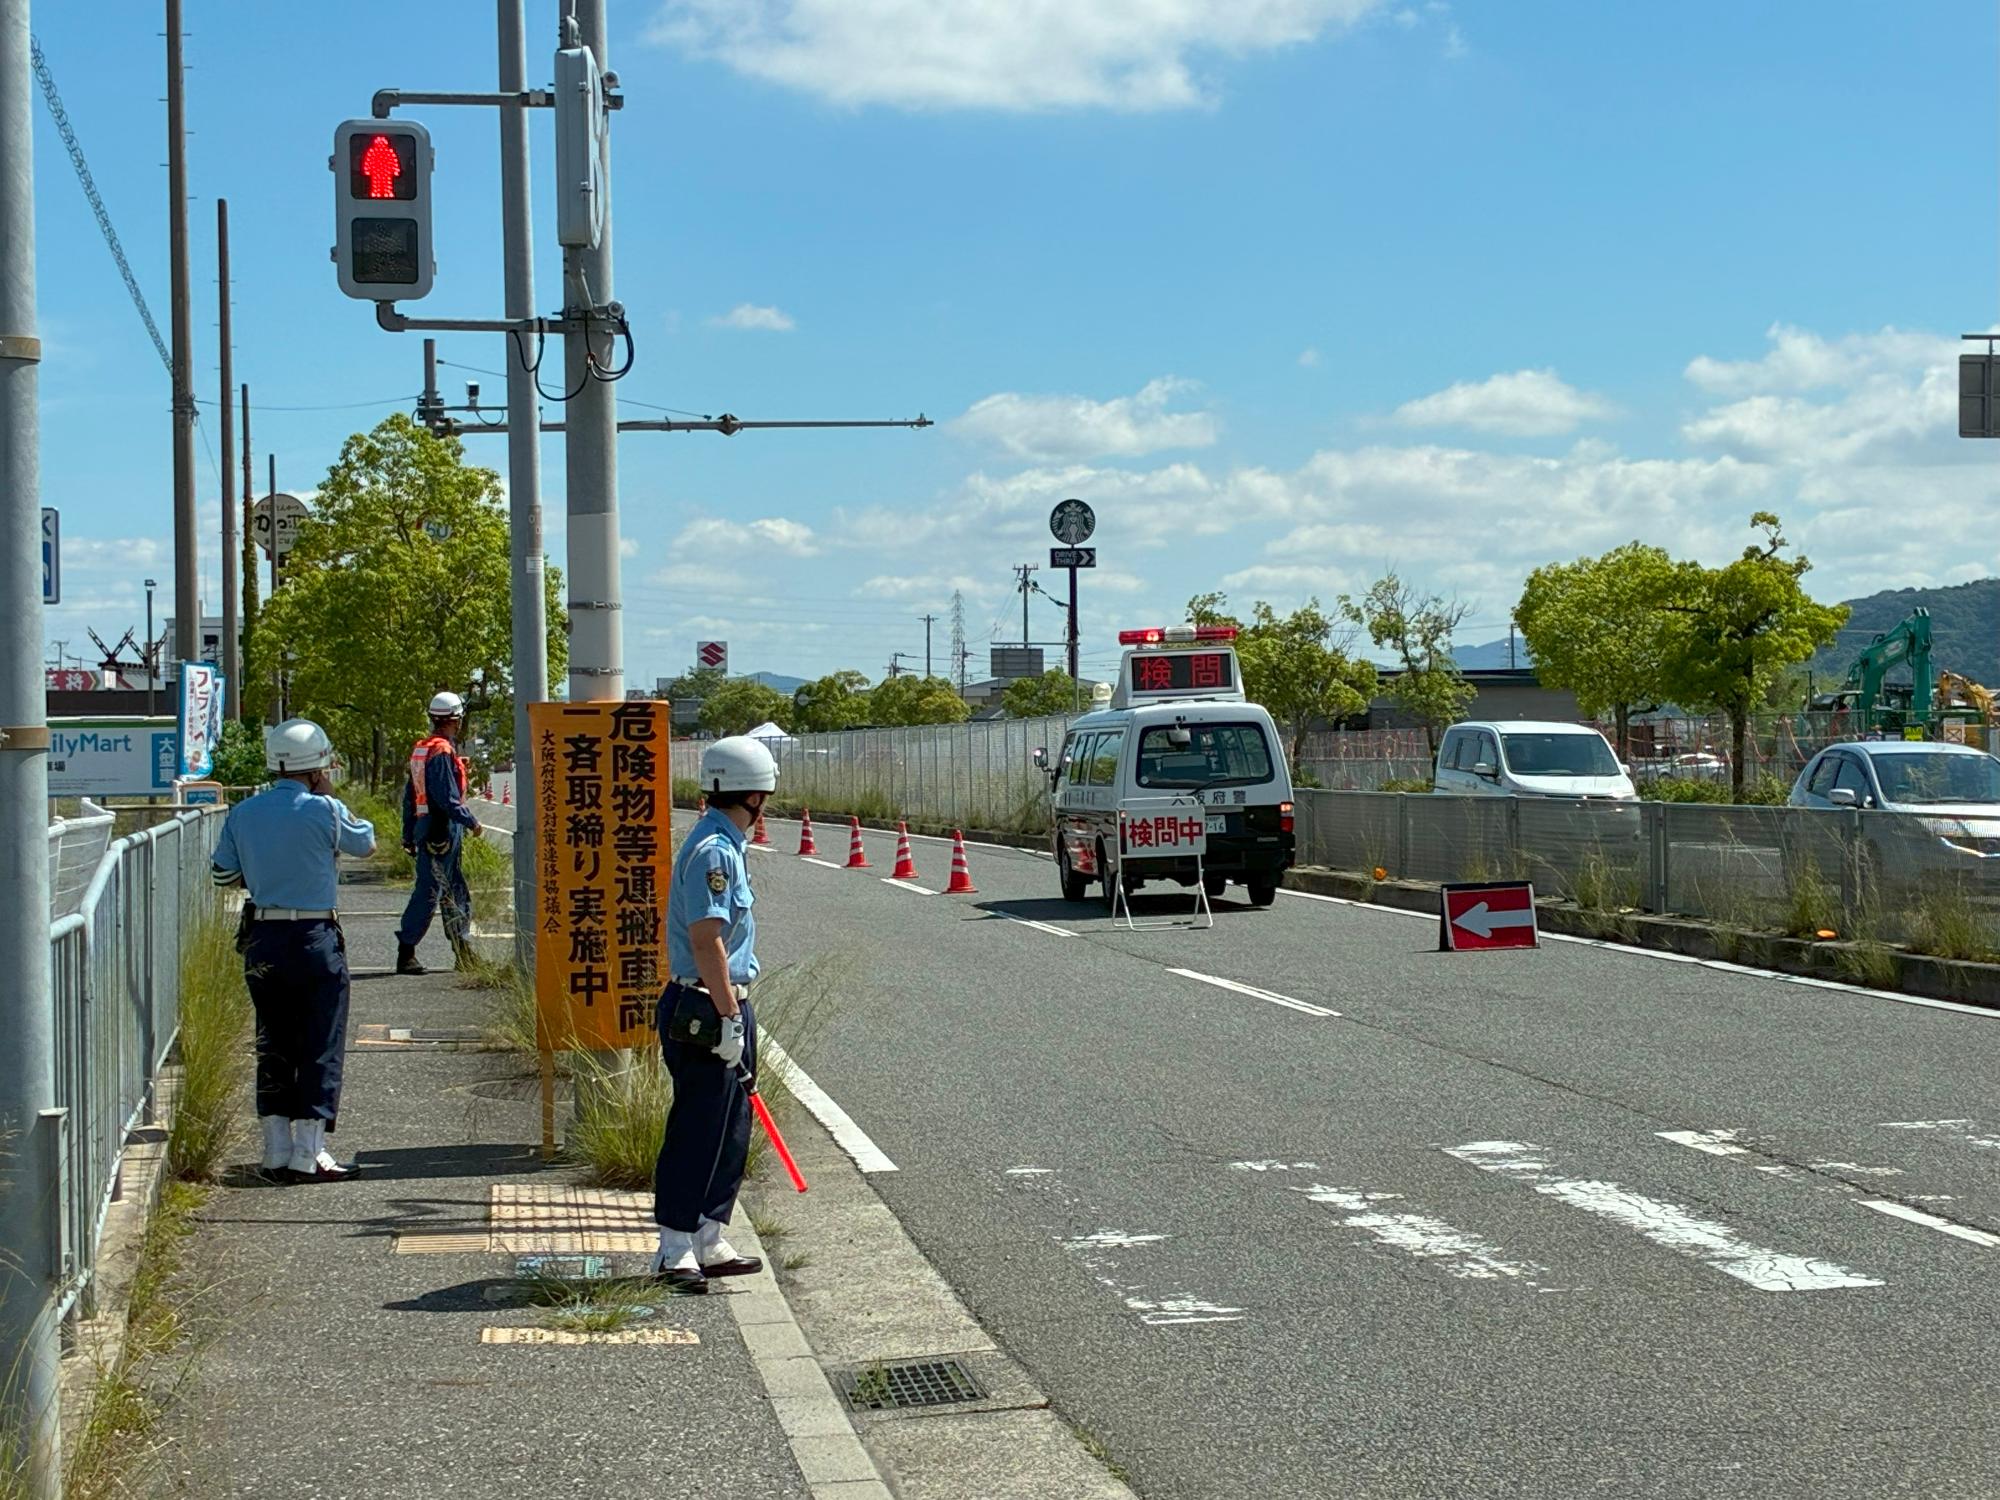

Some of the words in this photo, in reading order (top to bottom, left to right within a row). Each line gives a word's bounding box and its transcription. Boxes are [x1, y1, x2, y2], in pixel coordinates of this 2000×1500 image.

[1140, 656, 1221, 690] 検問
[541, 729, 562, 934] 大阪府災害対策連絡協議会
[562, 708, 608, 1007] 一斉取締り実施中
[608, 702, 662, 1033] 危険物等運搬車両
[1129, 816, 1203, 848] 検問中
